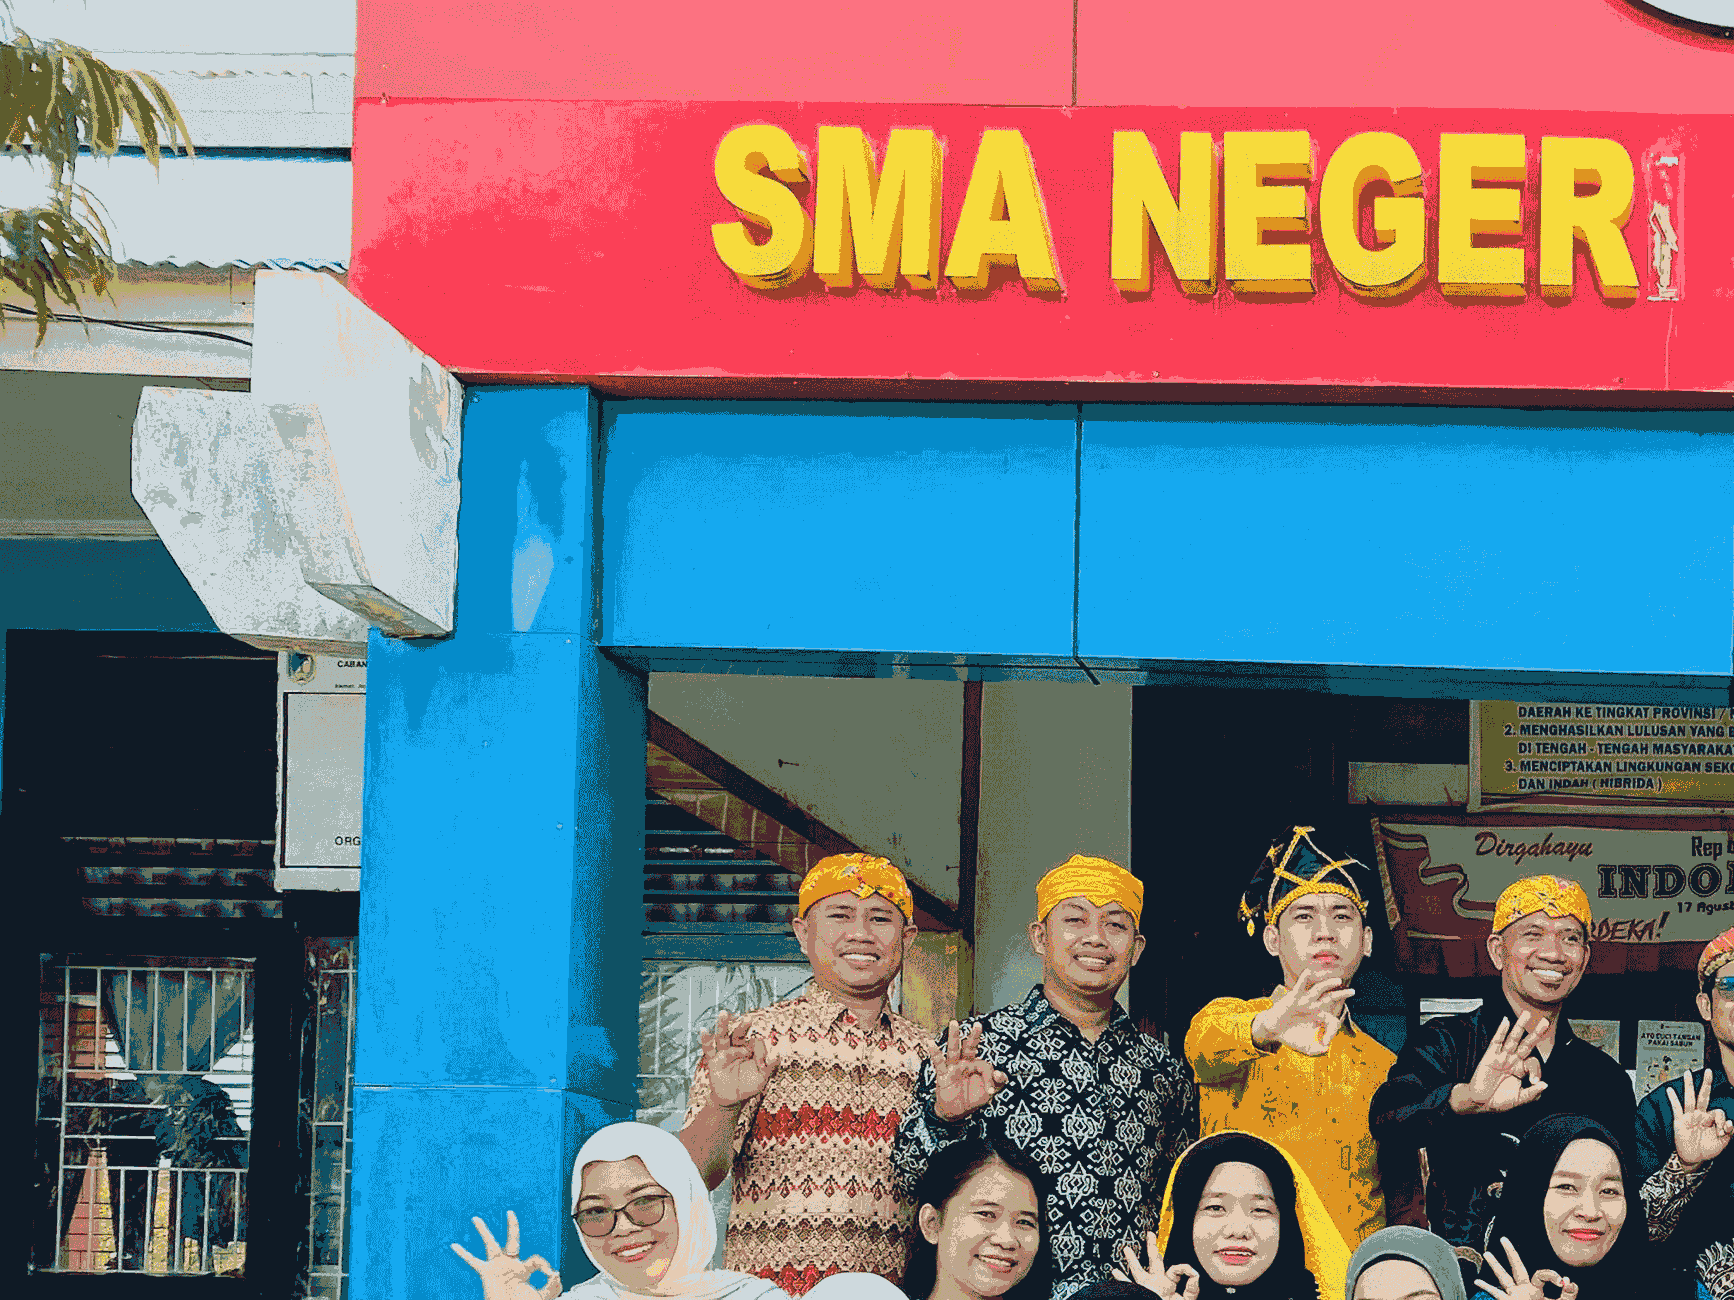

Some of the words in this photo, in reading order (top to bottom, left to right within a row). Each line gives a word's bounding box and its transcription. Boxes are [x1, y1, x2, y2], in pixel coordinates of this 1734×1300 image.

[711, 123, 1062, 292] SMA
[1518, 706, 1572, 718] DAERAH
[1575, 707, 1593, 718] KE
[1597, 707, 1650, 719] TINGKAT
[1652, 707, 1716, 720] PROVINSI
[1504, 725, 1517, 737] 2.
[1520, 724, 1624, 737] MENGHASILKAN
[1627, 725, 1686, 737] LULUSAN
[1689, 725, 1725, 738] YANG
[1518, 743, 1532, 755] DI
[1536, 743, 1587, 755] TENGAH
[1598, 743, 1649, 756] TENGAH
[1504, 761, 1517, 773] 3.
[1520, 760, 1612, 773] MENCIPTAKAN
[1616, 761, 1701, 774] LINGKUNGAN
[1518, 778, 1545, 790] DAN
[1549, 778, 1589, 789] INDAH
[1474, 831, 1593, 866] Dirgahayu
[1677, 901, 1693, 913] 17
